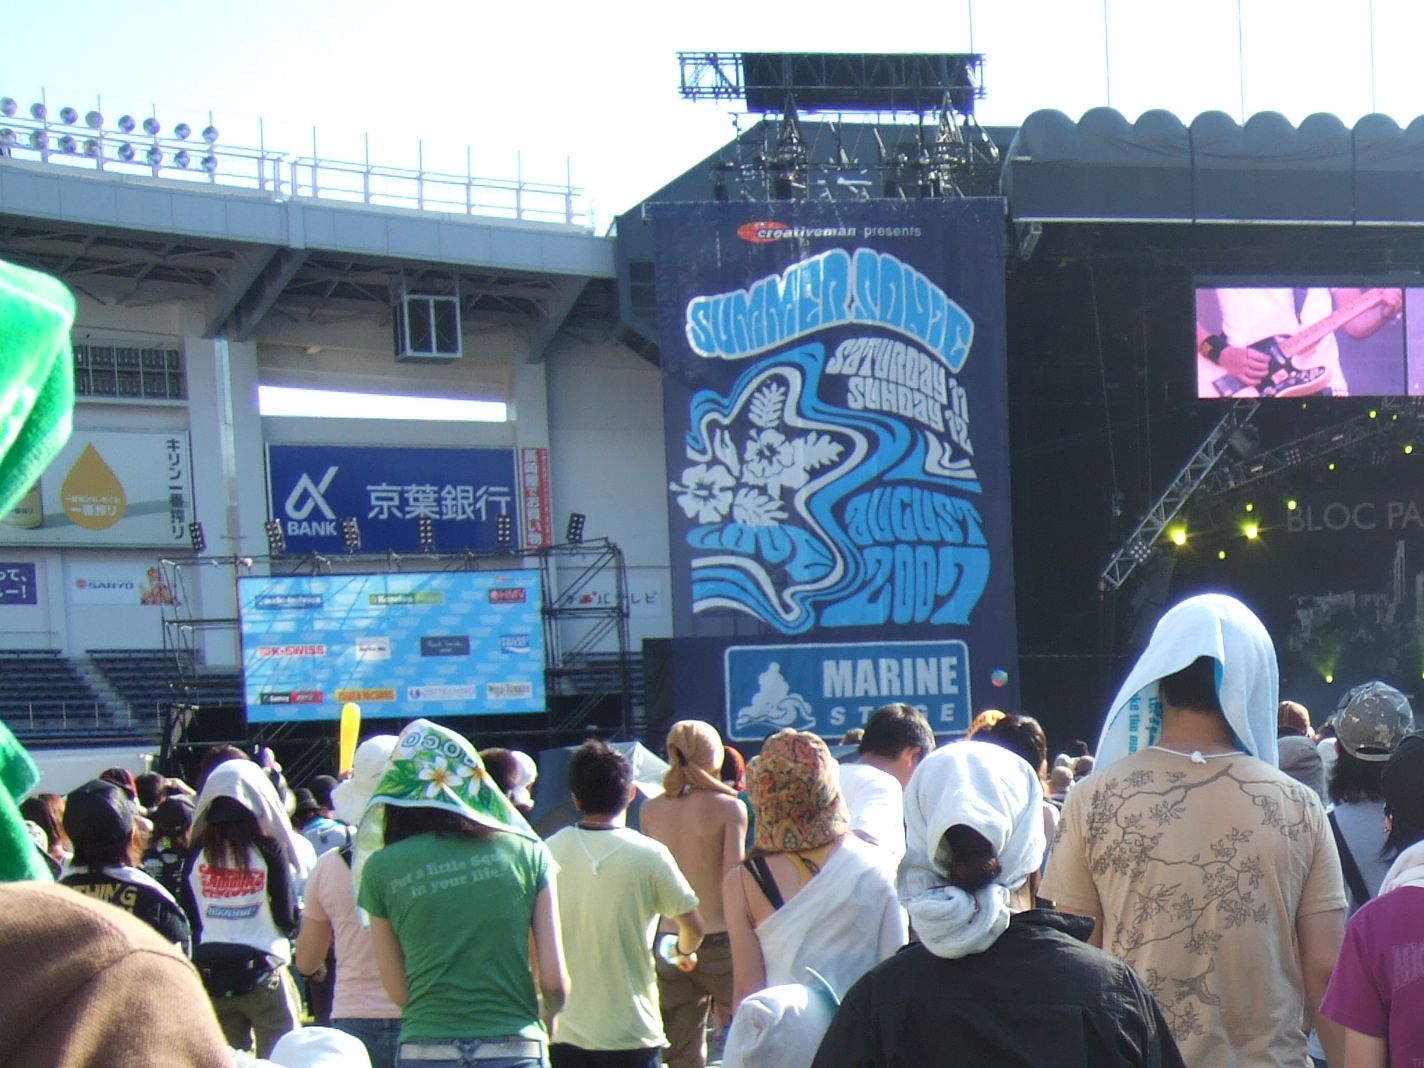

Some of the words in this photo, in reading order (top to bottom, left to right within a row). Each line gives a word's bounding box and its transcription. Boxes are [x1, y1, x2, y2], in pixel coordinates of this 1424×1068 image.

[757, 226, 857, 239] creativeman
[864, 226, 922, 239] presents
[686, 248, 851, 360] SUMMER
[851, 247, 975, 374] SONIC
[825, 337, 948, 405] SATURDAY
[847, 376, 945, 433] SUNDAY
[366, 482, 512, 522] 京葉銀行
[844, 487, 987, 545] AUGUST
[1286, 502, 1377, 532] BLOC
[287, 520, 337, 536] BANK
[88, 581, 134, 590] SANYO
[819, 544, 991, 627] 2007
[822, 656, 959, 698] MARINE
[829, 702, 956, 726] STGE
